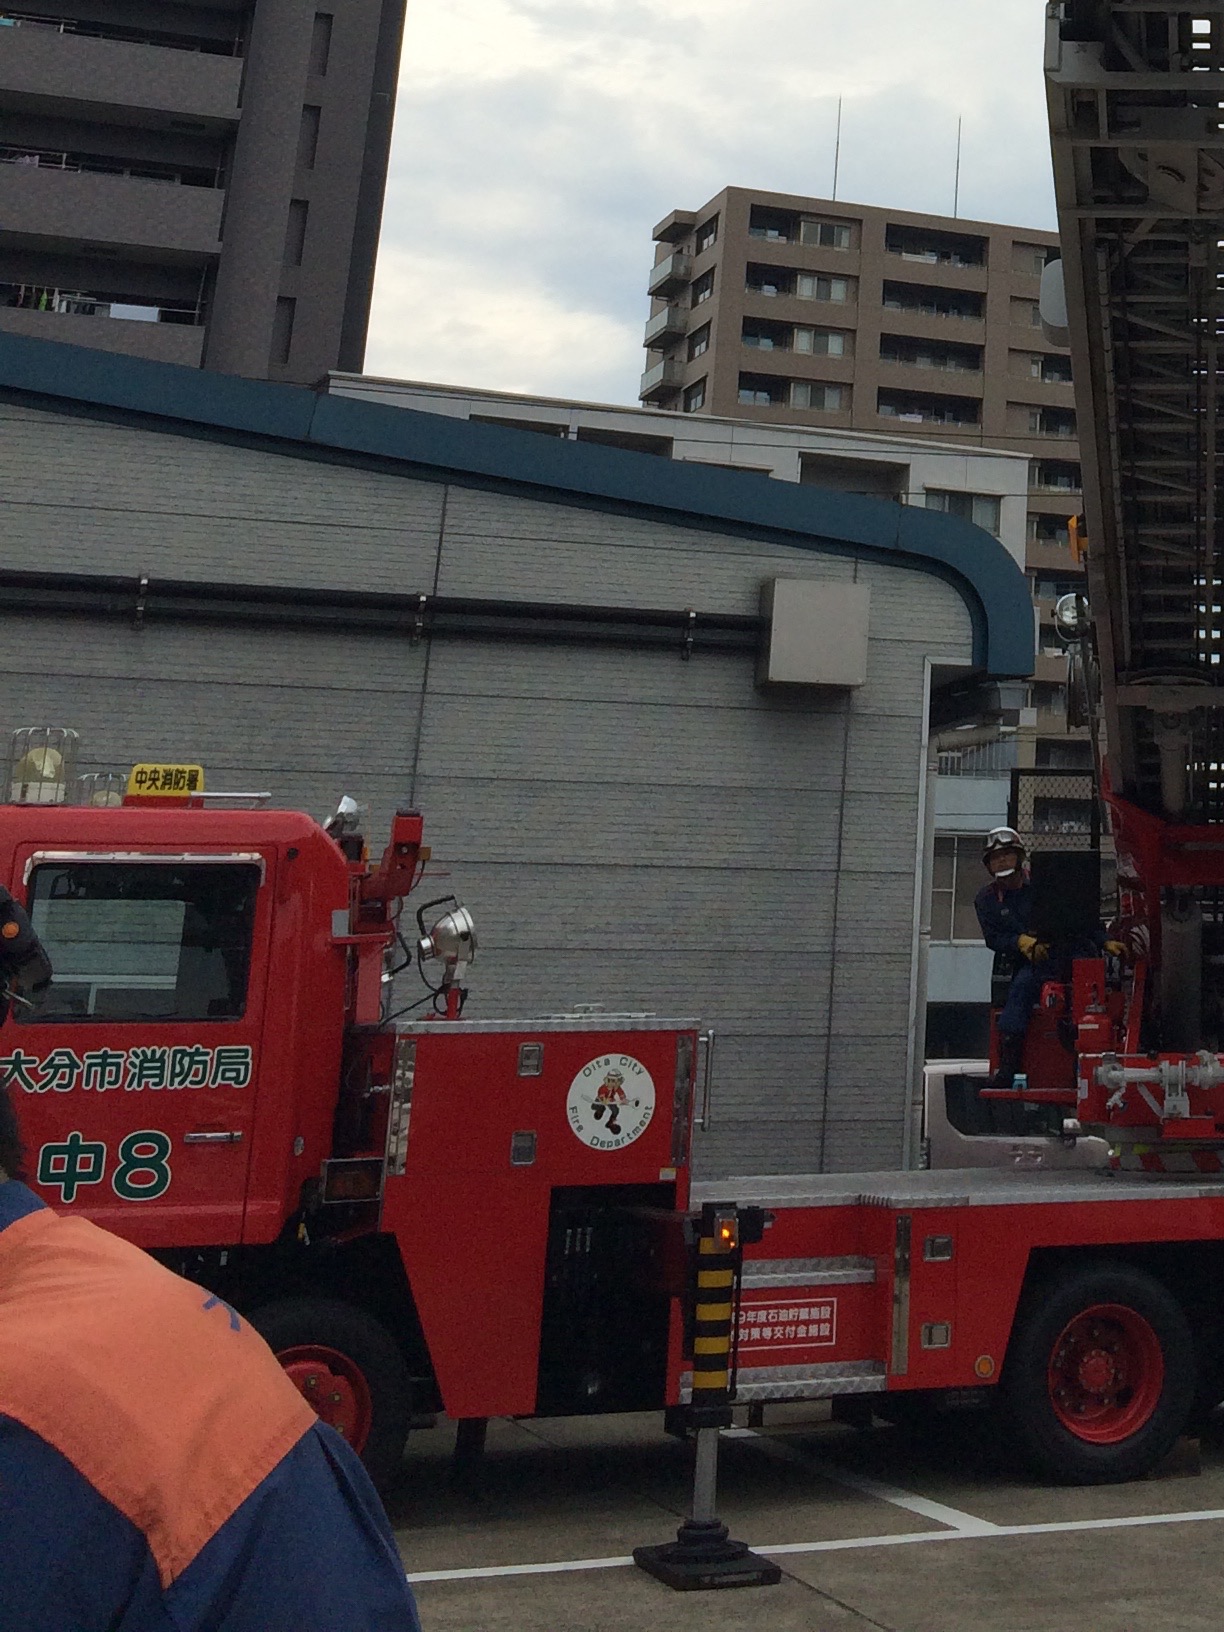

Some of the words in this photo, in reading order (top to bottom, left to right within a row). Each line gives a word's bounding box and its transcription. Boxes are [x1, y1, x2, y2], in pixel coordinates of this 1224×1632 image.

[135, 767, 199, 790] 中央消防署
[0, 1044, 252, 1093] 大分市消防局
[619, 1057, 645, 1075] City
[569, 1105, 584, 1133] Fire
[590, 1106, 652, 1148] Department
[37, 1130, 171, 1204] 中8
